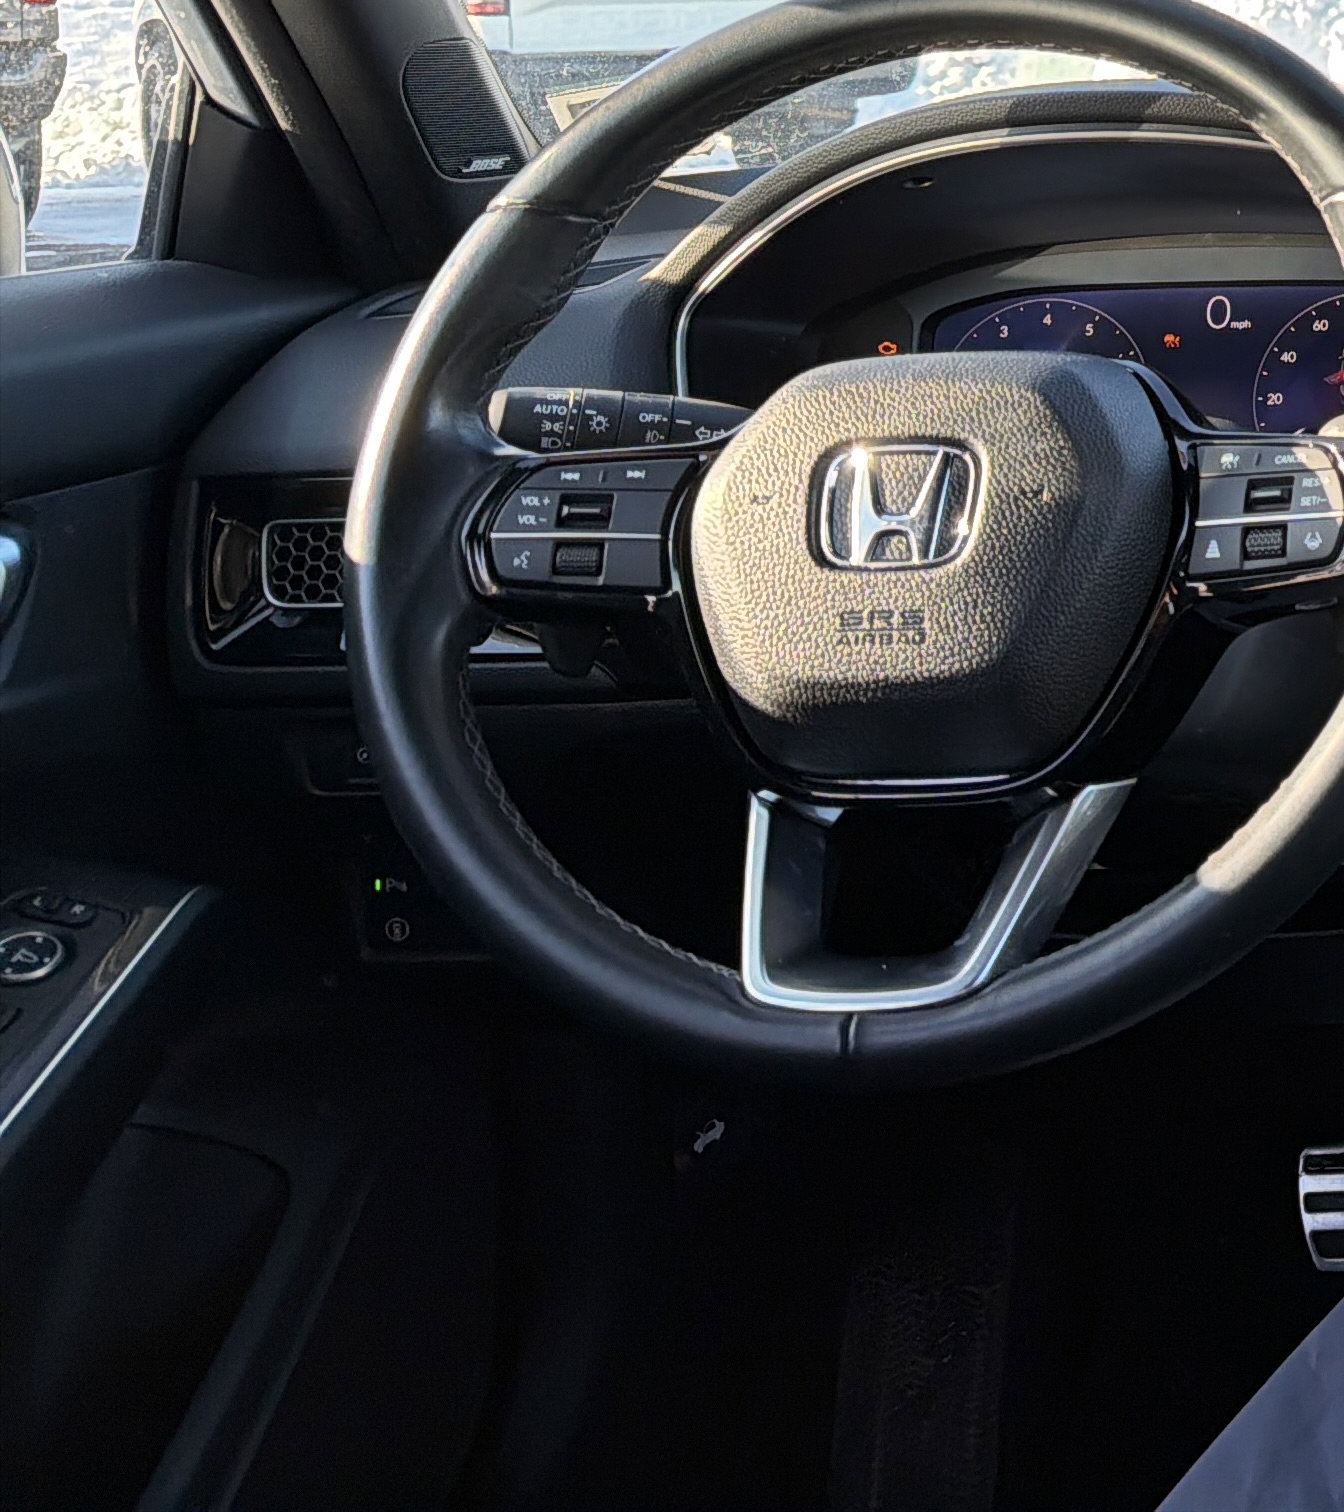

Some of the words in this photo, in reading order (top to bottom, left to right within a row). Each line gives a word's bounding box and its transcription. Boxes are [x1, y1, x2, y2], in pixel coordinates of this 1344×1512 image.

[462, 157, 511, 173] BOSE
[1206, 295, 1231, 330] 0
[1230, 319, 1252, 330] mph
[1042, 313, 1052, 326] 4
[1312, 319, 1329, 332] 60
[999, 325, 1009, 338] 3
[1085, 323, 1094, 337] 5
[1280, 351, 1297, 364] 40
[1266, 392, 1283, 406] 20
[533, 403, 568, 416] AUTO
[639, 412, 662, 424] OFF
[520, 495, 540, 507] VOL
[517, 514, 538, 526] VOL
[839, 610, 925, 628] SRS
